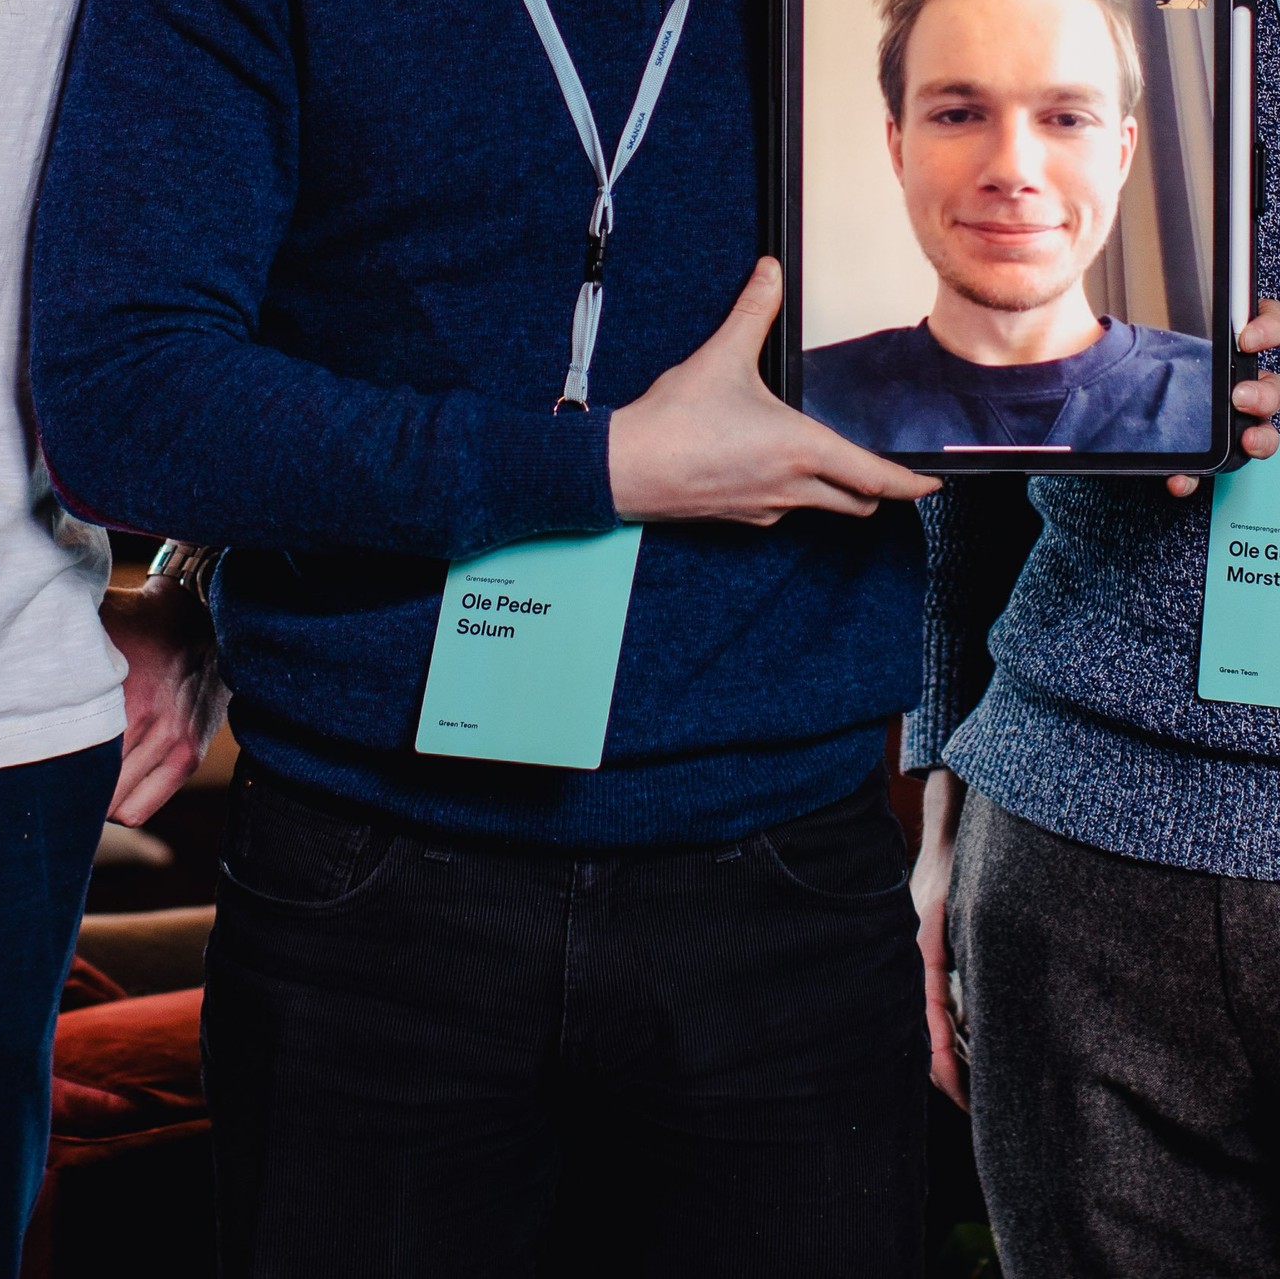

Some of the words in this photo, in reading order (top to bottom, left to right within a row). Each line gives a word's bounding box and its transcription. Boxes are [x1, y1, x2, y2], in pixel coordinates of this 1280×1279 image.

[655, 30, 673, 67] SKANSKA
[626, 112, 645, 151] SKANSKA
[1229, 521, 1280, 534] Grensesprenger
[1228, 540, 1260, 559] Ole
[465, 574, 516, 586] Grensesprenger
[461, 592, 492, 611] Ole
[496, 595, 552, 616] Peder
[456, 618, 515, 639] Solum
[1218, 666, 1240, 675] Green
[1240, 668, 1259, 677] Team
[438, 719, 459, 728] Green
[460, 721, 479, 729] Team
